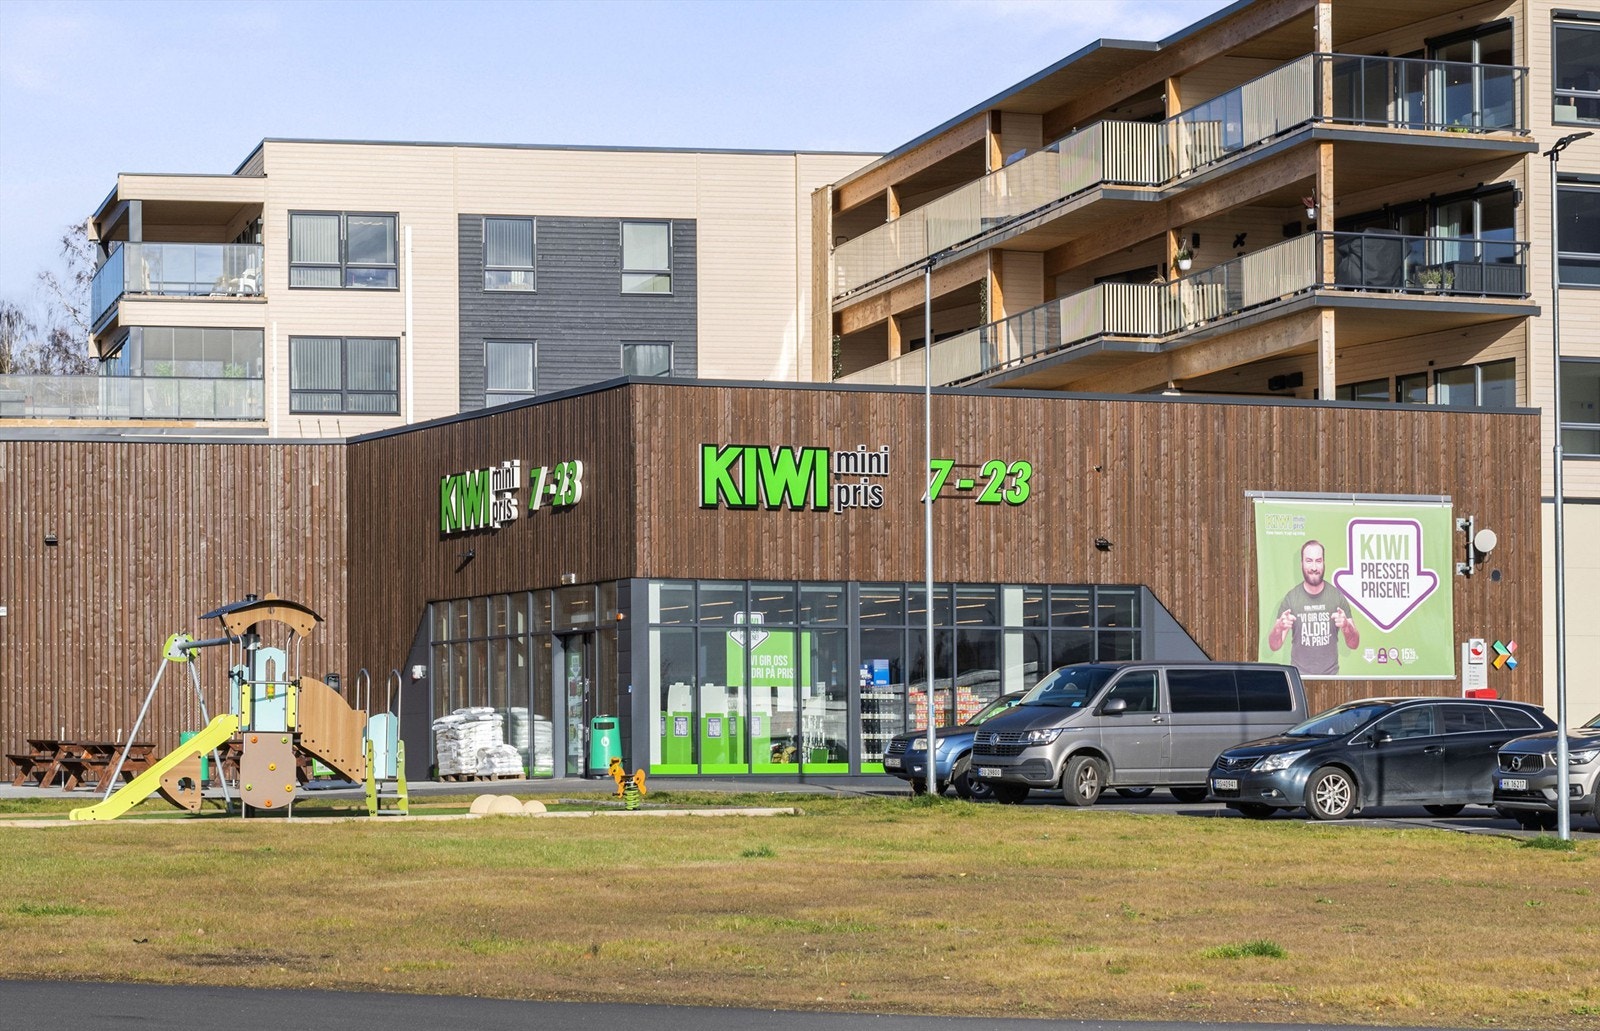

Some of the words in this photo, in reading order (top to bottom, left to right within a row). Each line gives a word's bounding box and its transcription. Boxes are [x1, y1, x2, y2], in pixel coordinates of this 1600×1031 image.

[834, 445, 889, 475] mini
[491, 460, 519, 491] mini
[699, 444, 830, 510] KIWI
[440, 468, 492, 532] KIWI
[834, 477, 884, 513] pris
[491, 493, 518, 527] pris
[1265, 514, 1292, 530] KIWI
[1360, 533, 1410, 561] KIWI
[1360, 562, 1410, 580] PRESSER
[1361, 581, 1410, 599] PRISENE!
[1307, 612, 1318, 622] GIR
[1318, 612, 1330, 622] OSS
[1301, 621, 1330, 637] ALDRI
[760, 654, 772, 666] GIR
[773, 654, 788, 666] OSS
[765, 664, 776, 679] PÅ
